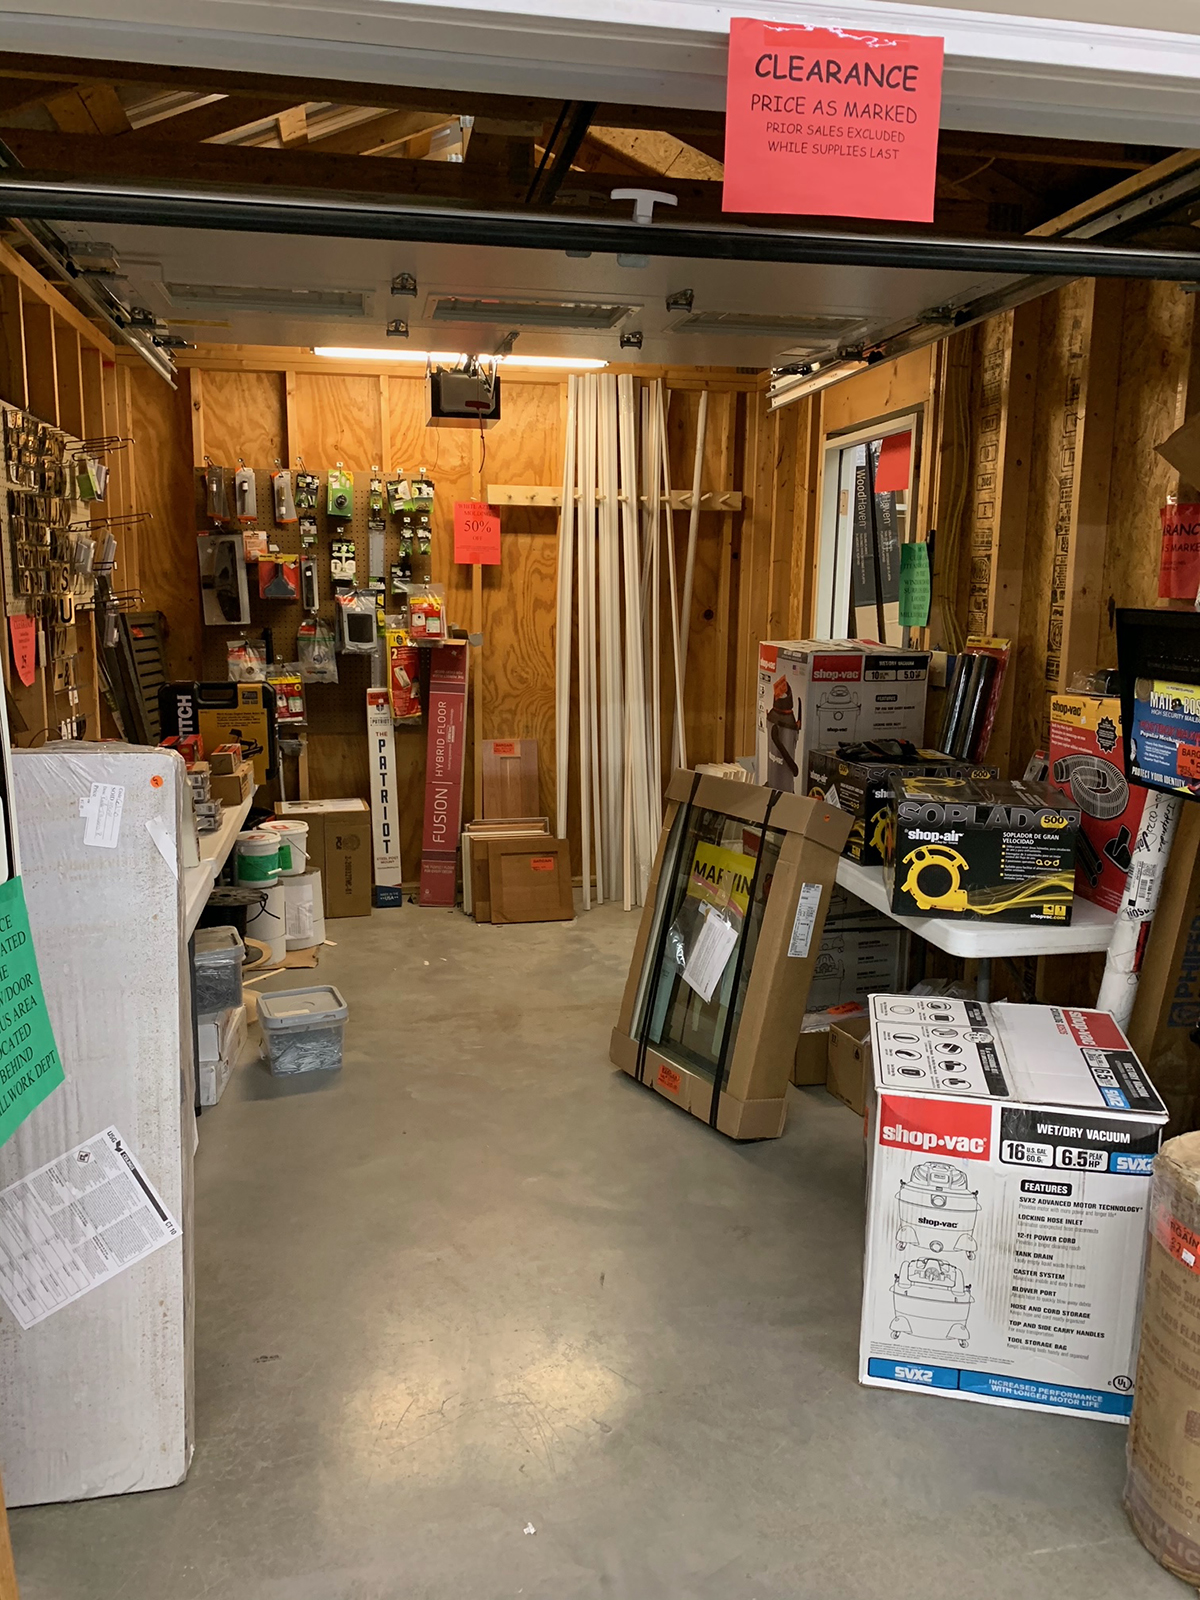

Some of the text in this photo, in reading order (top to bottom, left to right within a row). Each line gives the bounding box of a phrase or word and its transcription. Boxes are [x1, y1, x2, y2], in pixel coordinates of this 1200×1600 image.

[755, 54, 919, 91] CLEARANCE
[751, 94, 917, 123] PRICE AS MARKED
[766, 122, 905, 142] PRIOR SALES EXCLUDED
[768, 141, 899, 159] WHILE SUPPLIES LAST
[856, 468, 867, 528] WoodHaven
[464, 520, 492, 533] 50%
[871, 671, 879, 680] 10
[1150, 691, 1173, 711] MAIL
[177, 694, 193, 737] ITCH
[1163, 710, 1184, 719] SECURITY
[435, 701, 447, 777] HYBRID FLOOR
[1132, 766, 1150, 780] PROTECT
[1151, 771, 1164, 782] YOUR
[378, 739, 391, 854] PATRIOT
[433, 788, 448, 843] FUSION
[1043, 815, 1064, 824] 500
[1030, 913, 1066, 921] shopvac.com
[14, 994, 38, 1023] AREA
[0, 1046, 34, 1085] BEHIND
[34, 1050, 56, 1079] DEPT
[107, 1131, 117, 1143] USG
[1037, 1123, 1131, 1144] WET/DRY VACUUM
[1006, 1142, 1026, 1161] 16
[1061, 1149, 1103, 1168] 6.5 PEAK
[1088, 1160, 1101, 1169] HP
[1024, 1182, 1068, 1194] FEATURES
[1019, 1196, 1037, 1204] SVX2
[1037, 1198, 1072, 1207] ADVANCED
[1073, 1201, 1097, 1210] MOTOR
[165, 1221, 173, 1229] CT
[1018, 1214, 1045, 1222] LOCKING
[1065, 1218, 1083, 1226] INLET
[1017, 1232, 1076, 1244] 12-ft POWER CORD
[1015, 1250, 1053, 1260] TANK DRAIN
[1013, 1268, 1065, 1280] CASTER SYSTEM
[1012, 1285, 1057, 1297] BLOWER PORT
[1010, 1302, 1027, 1311] HOSE
[1043, 1307, 1061, 1315] CORD
[1062, 1309, 1091, 1319] STORAGE
[1009, 1319, 1105, 1339] TOP AND SIDE CARRY HANDLES
[1007, 1336, 1067, 1351] TOOL STORAGE BAG
[894, 1366, 934, 1383] SVX2
[988, 1379, 1103, 1403] INCREASED PERFORMANCE
[991, 1384, 1099, 1408] WITH LONGER MOTOR LIFE
